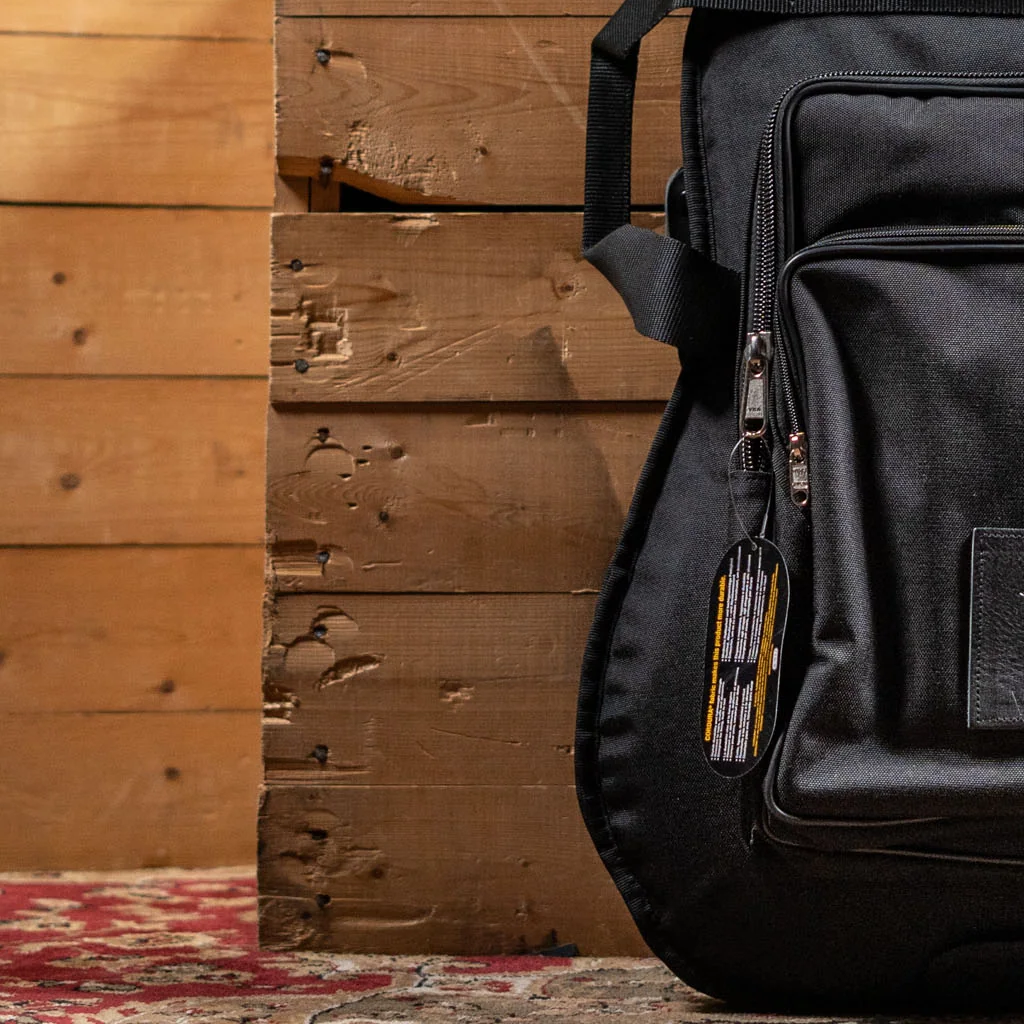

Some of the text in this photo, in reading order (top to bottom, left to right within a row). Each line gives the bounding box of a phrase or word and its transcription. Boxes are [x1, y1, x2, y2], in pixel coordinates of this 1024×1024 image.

[714, 621, 723, 648] product
[713, 648, 721, 661] this
[711, 661, 719, 685] makes
[709, 685, 717, 705] fabric
